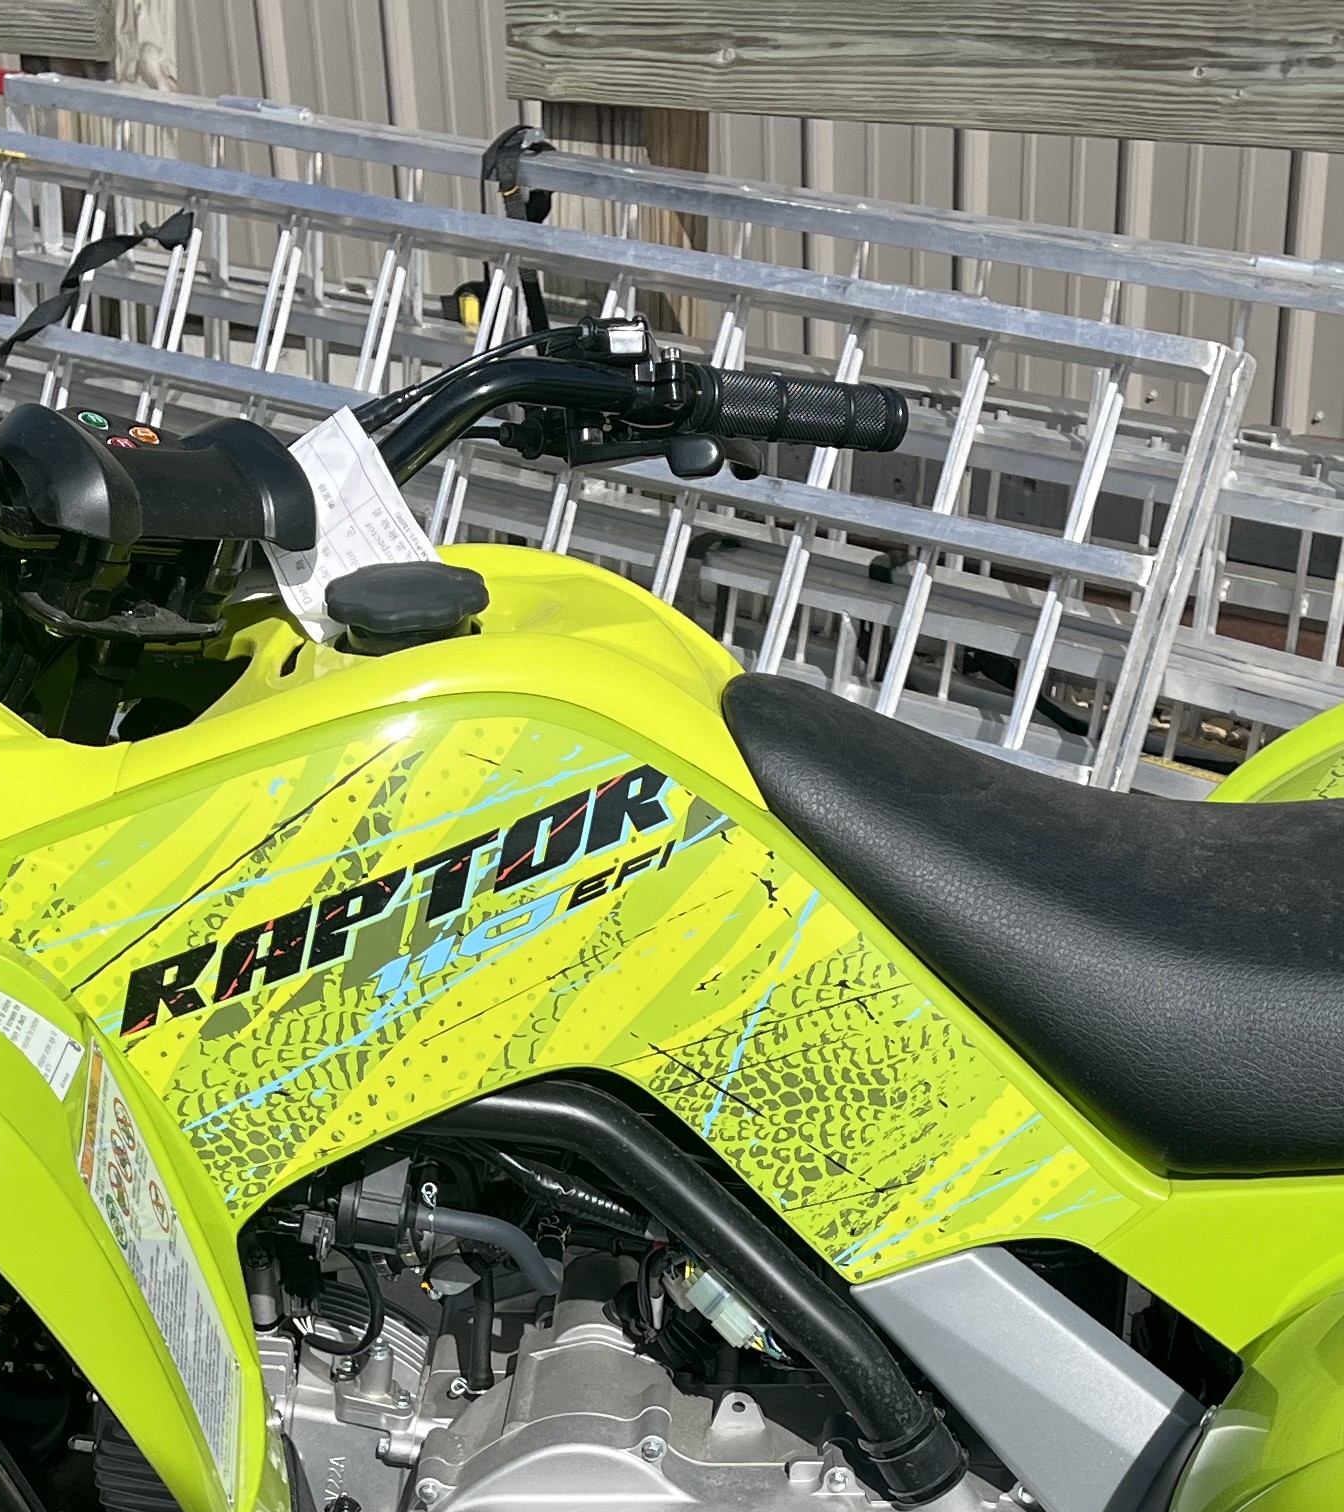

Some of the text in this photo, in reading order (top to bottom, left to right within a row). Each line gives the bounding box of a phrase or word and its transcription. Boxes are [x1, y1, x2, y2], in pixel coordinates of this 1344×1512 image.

[119, 763, 680, 1038] RAPTOR
[566, 840, 675, 914] EFI
[368, 886, 565, 999] 110
